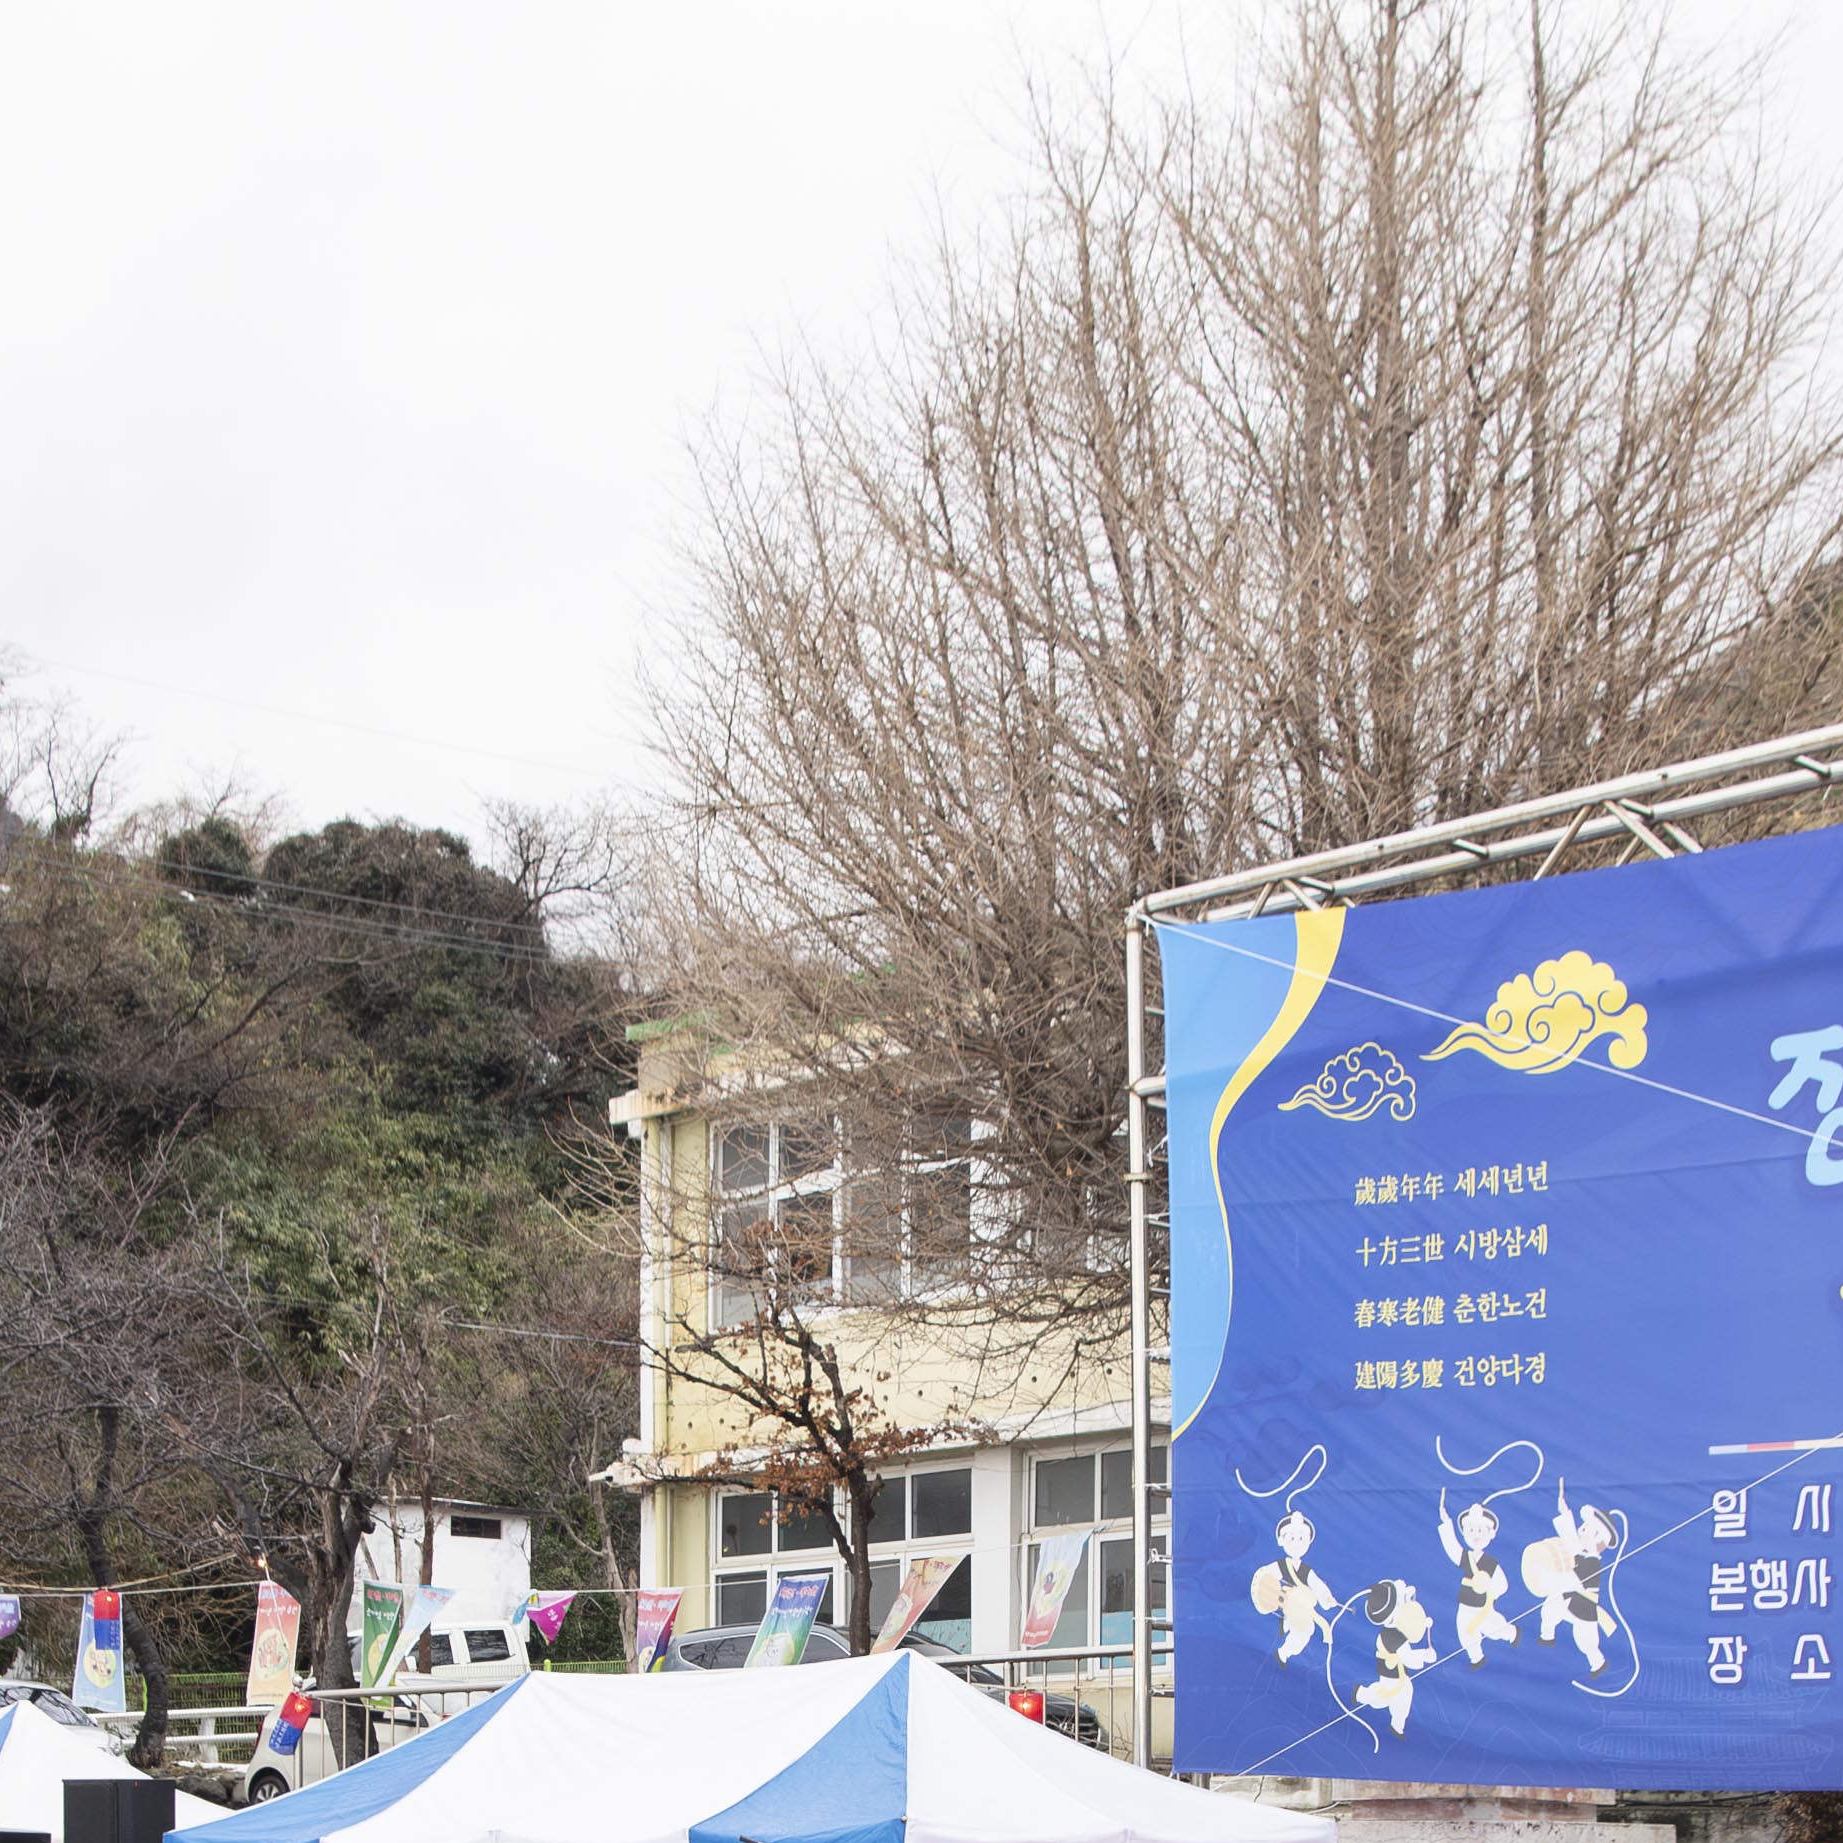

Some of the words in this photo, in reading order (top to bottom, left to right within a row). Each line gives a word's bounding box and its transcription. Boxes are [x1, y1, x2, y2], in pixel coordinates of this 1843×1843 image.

[1454, 1160, 1548, 1198] 세세년년
[1355, 1233, 1445, 1267] 十方三世
[1454, 1224, 1548, 1261] 시방삼세
[1354, 1295, 1445, 1328] 春寒老健
[1453, 1288, 1547, 1324] 춘한노건
[1354, 1358, 1444, 1390] 建陽多慶
[1454, 1352, 1546, 1387] 건양다경
[1709, 1558, 1830, 1611] 본행사
